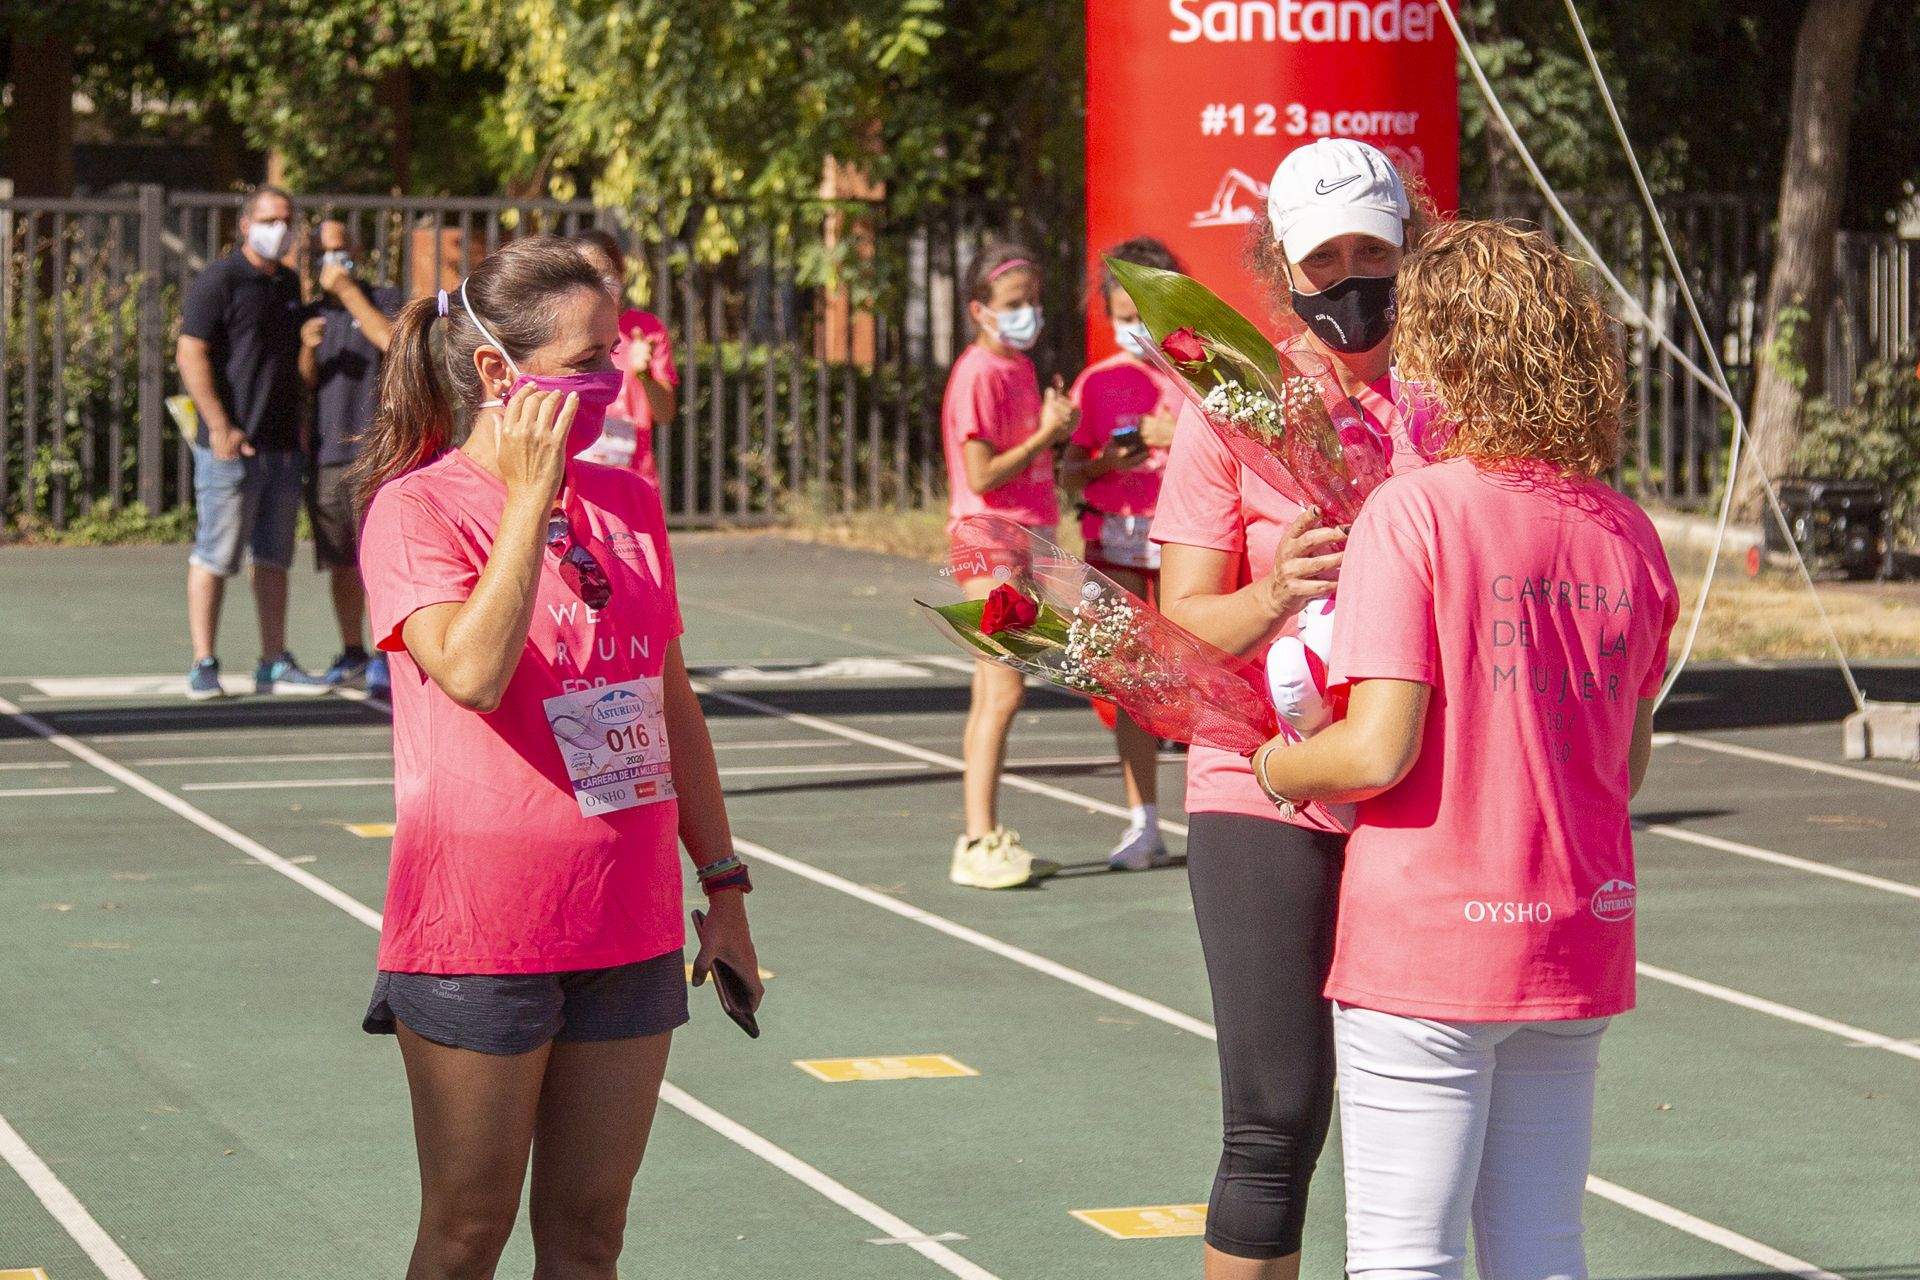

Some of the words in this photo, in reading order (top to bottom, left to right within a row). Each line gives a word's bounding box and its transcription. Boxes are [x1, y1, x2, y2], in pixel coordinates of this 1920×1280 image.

[1169, 0, 1438, 43] Santander
[1492, 575, 1634, 615] CARRERA
[548, 602, 600, 626] WE
[557, 636, 649, 665] RUN
[1493, 621, 1530, 648] DE
[1599, 626, 1627, 659] LA
[1493, 665, 1620, 703] MUJER
[606, 724, 651, 753] 016
[625, 754, 645, 766] 2020
[581, 772, 618, 789] CARRERA
[619, 770, 630, 782] DE
[631, 768, 640, 780] LA
[640, 765, 660, 778] MUJER
[585, 788, 626, 808] OYSHO
[1464, 901, 1552, 923] OYSHO
